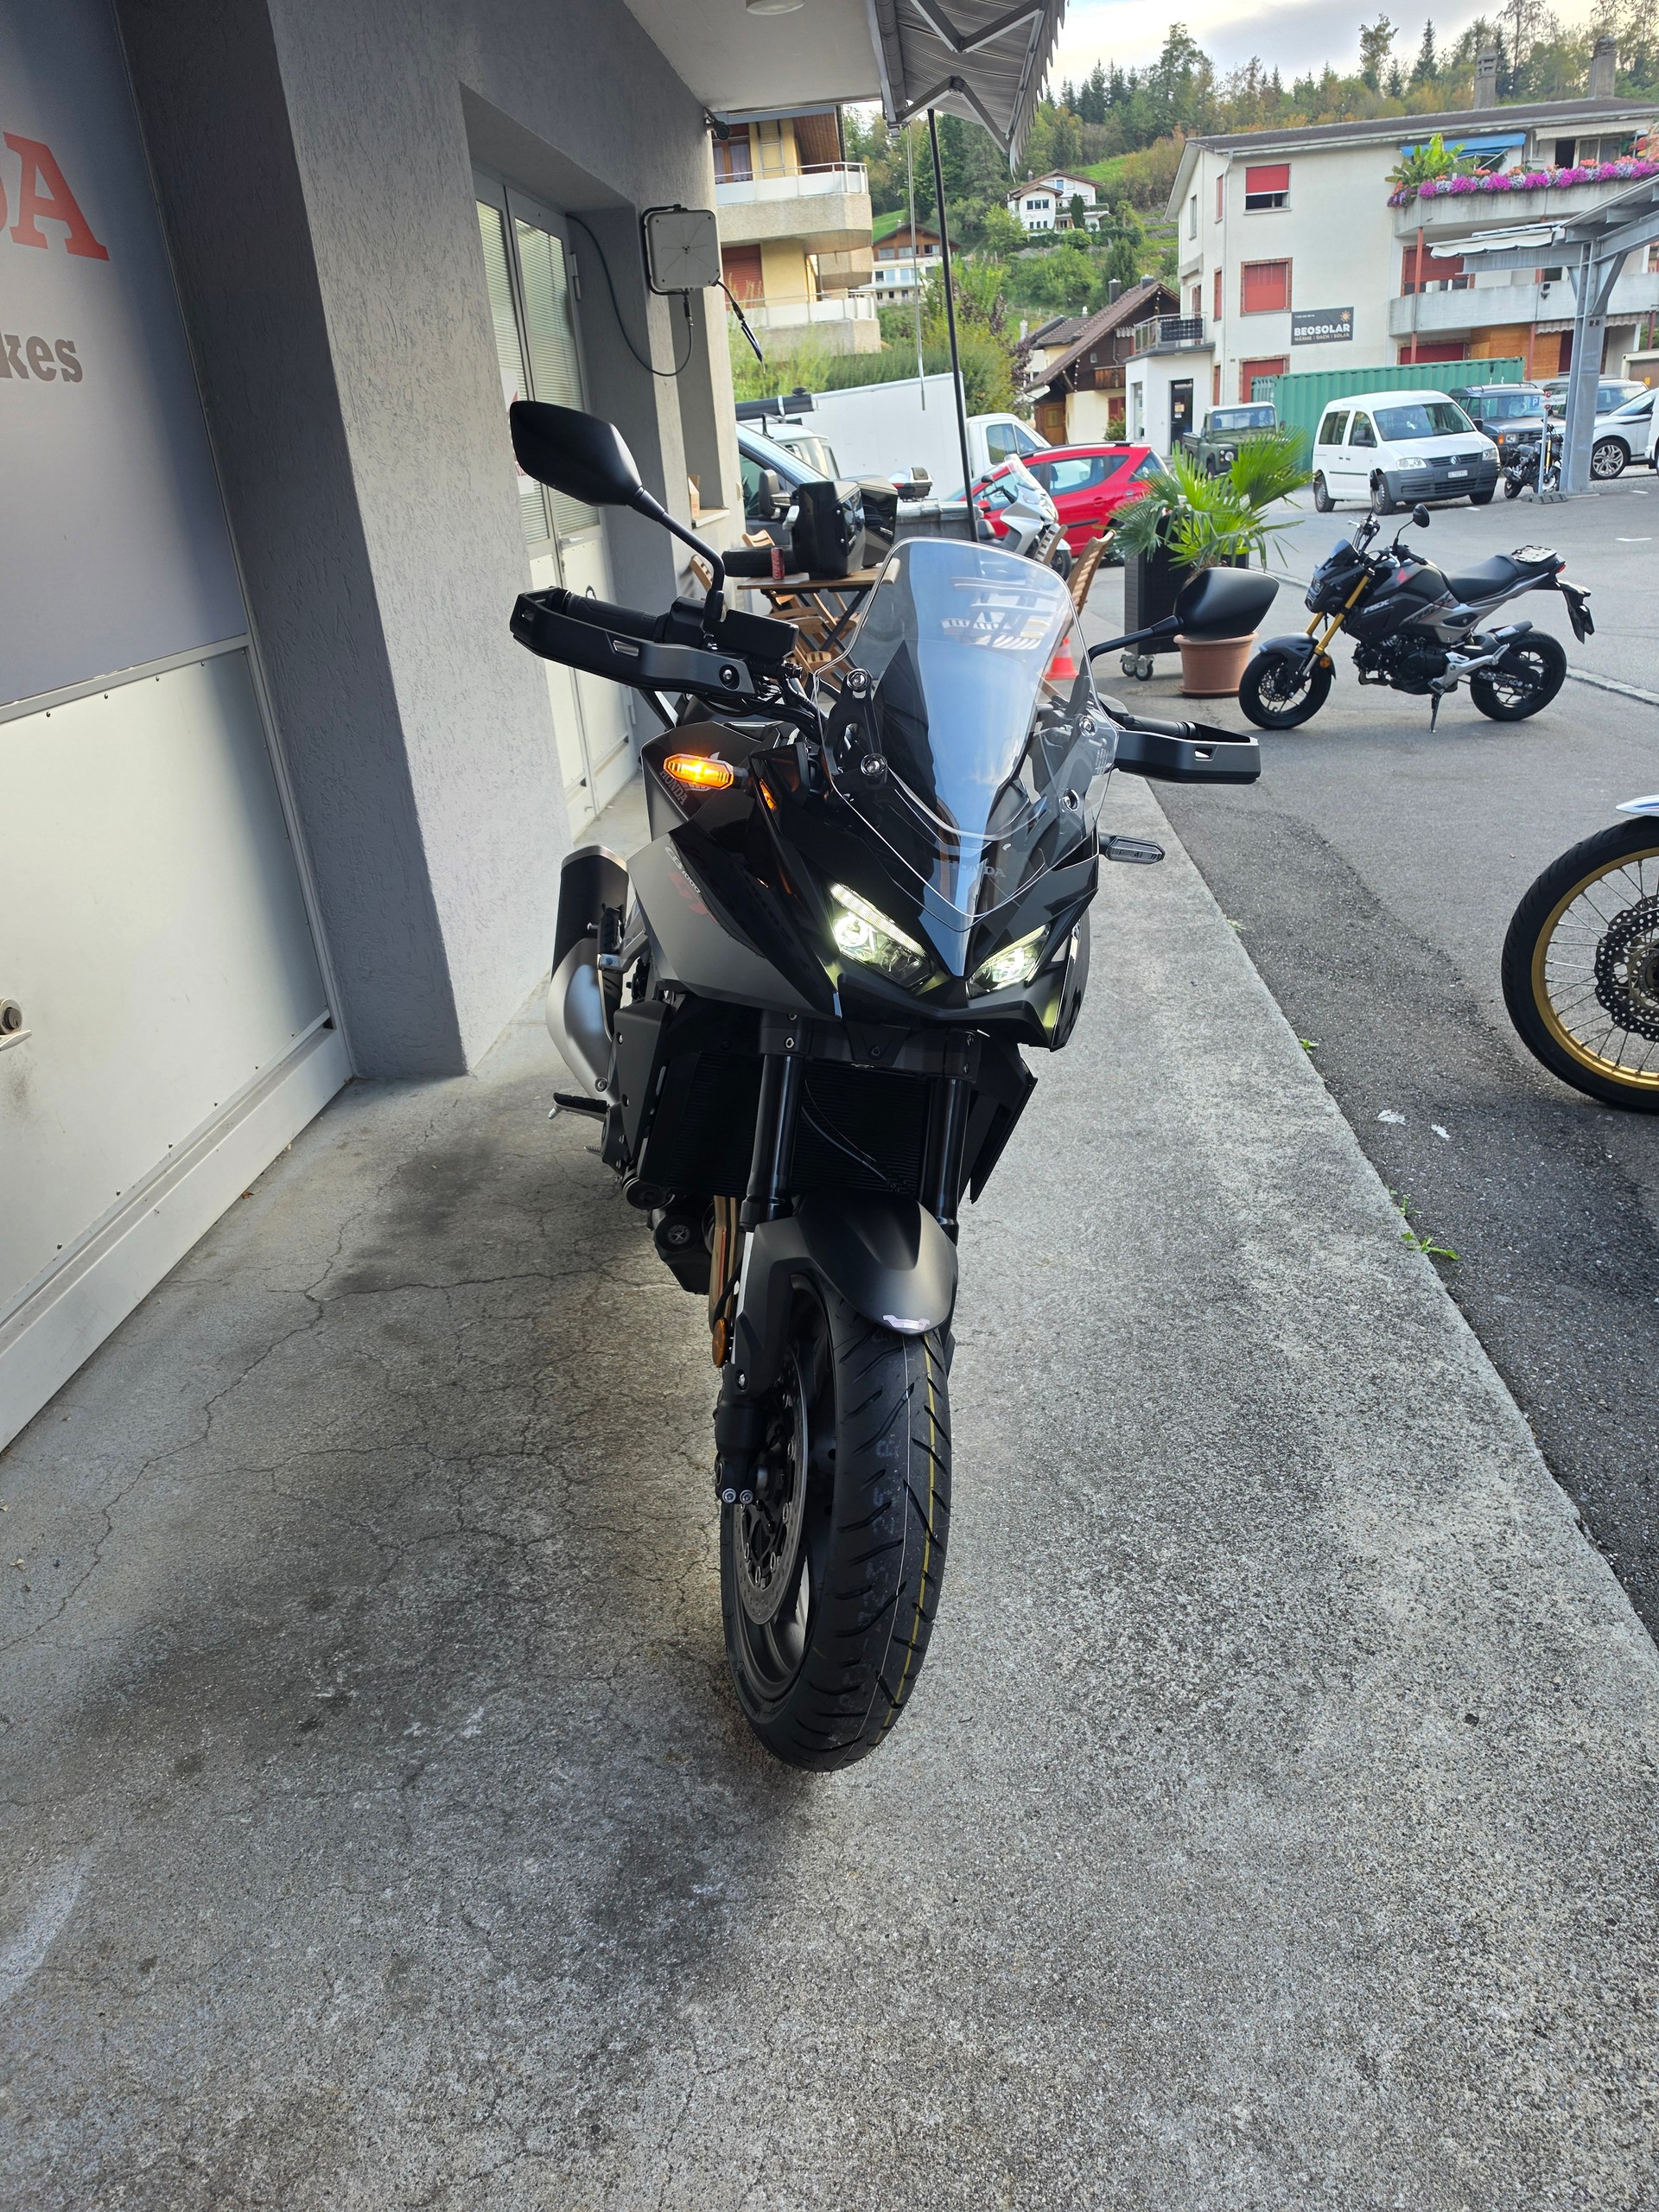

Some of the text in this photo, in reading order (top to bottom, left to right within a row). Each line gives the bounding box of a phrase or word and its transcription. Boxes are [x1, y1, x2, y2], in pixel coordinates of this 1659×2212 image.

[0, 131, 110, 261] A
[1294, 323, 1351, 337] BEOSOLAR
[0, 332, 83, 383] kes
[659, 768, 689, 806] HONDA
